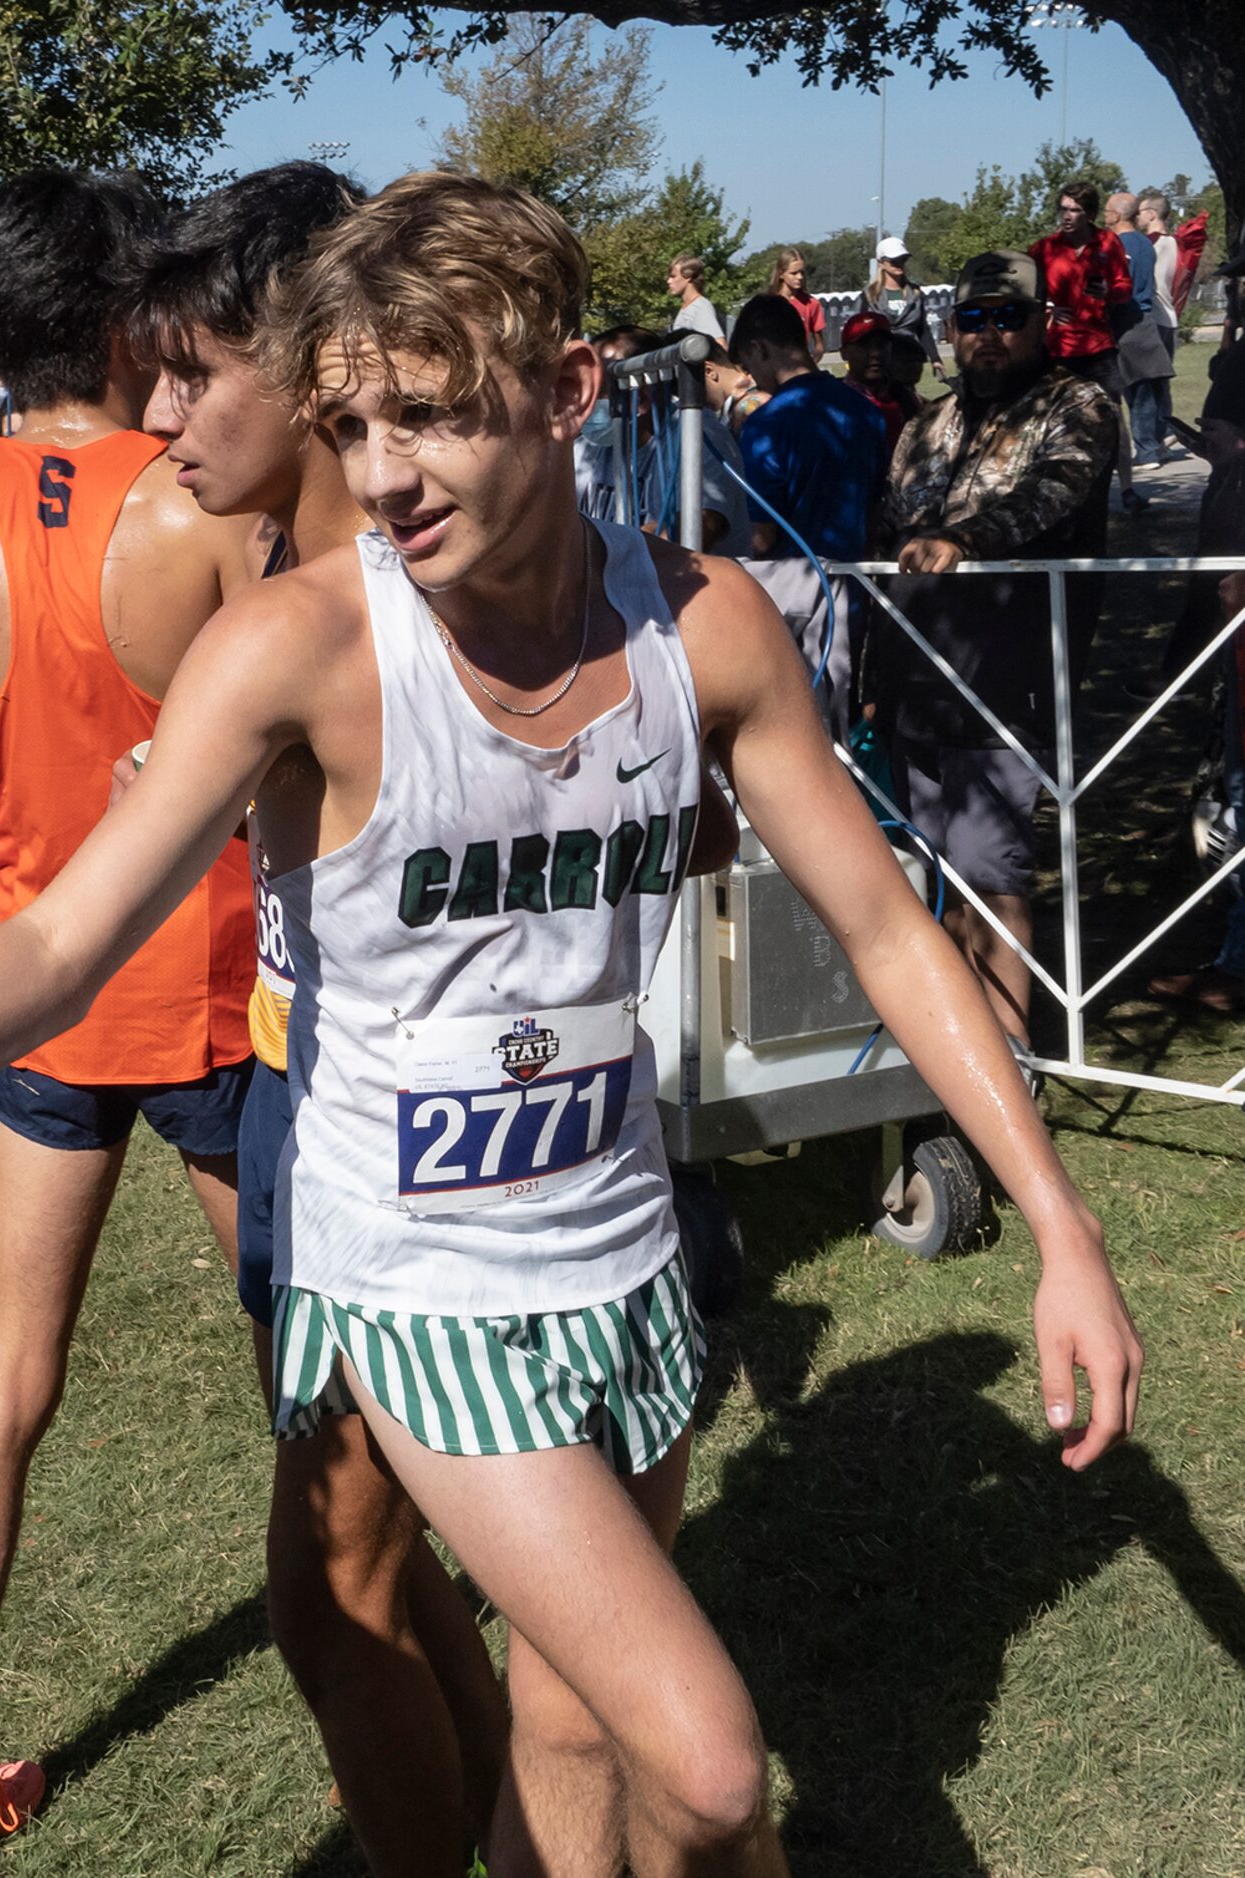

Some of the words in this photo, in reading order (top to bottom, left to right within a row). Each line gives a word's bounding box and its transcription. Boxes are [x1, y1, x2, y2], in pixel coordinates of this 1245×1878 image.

[37, 455, 76, 528] S
[493, 1039, 559, 1062] STATE
[412, 1072, 607, 1183] 2771
[505, 1180, 540, 1198] 2021
